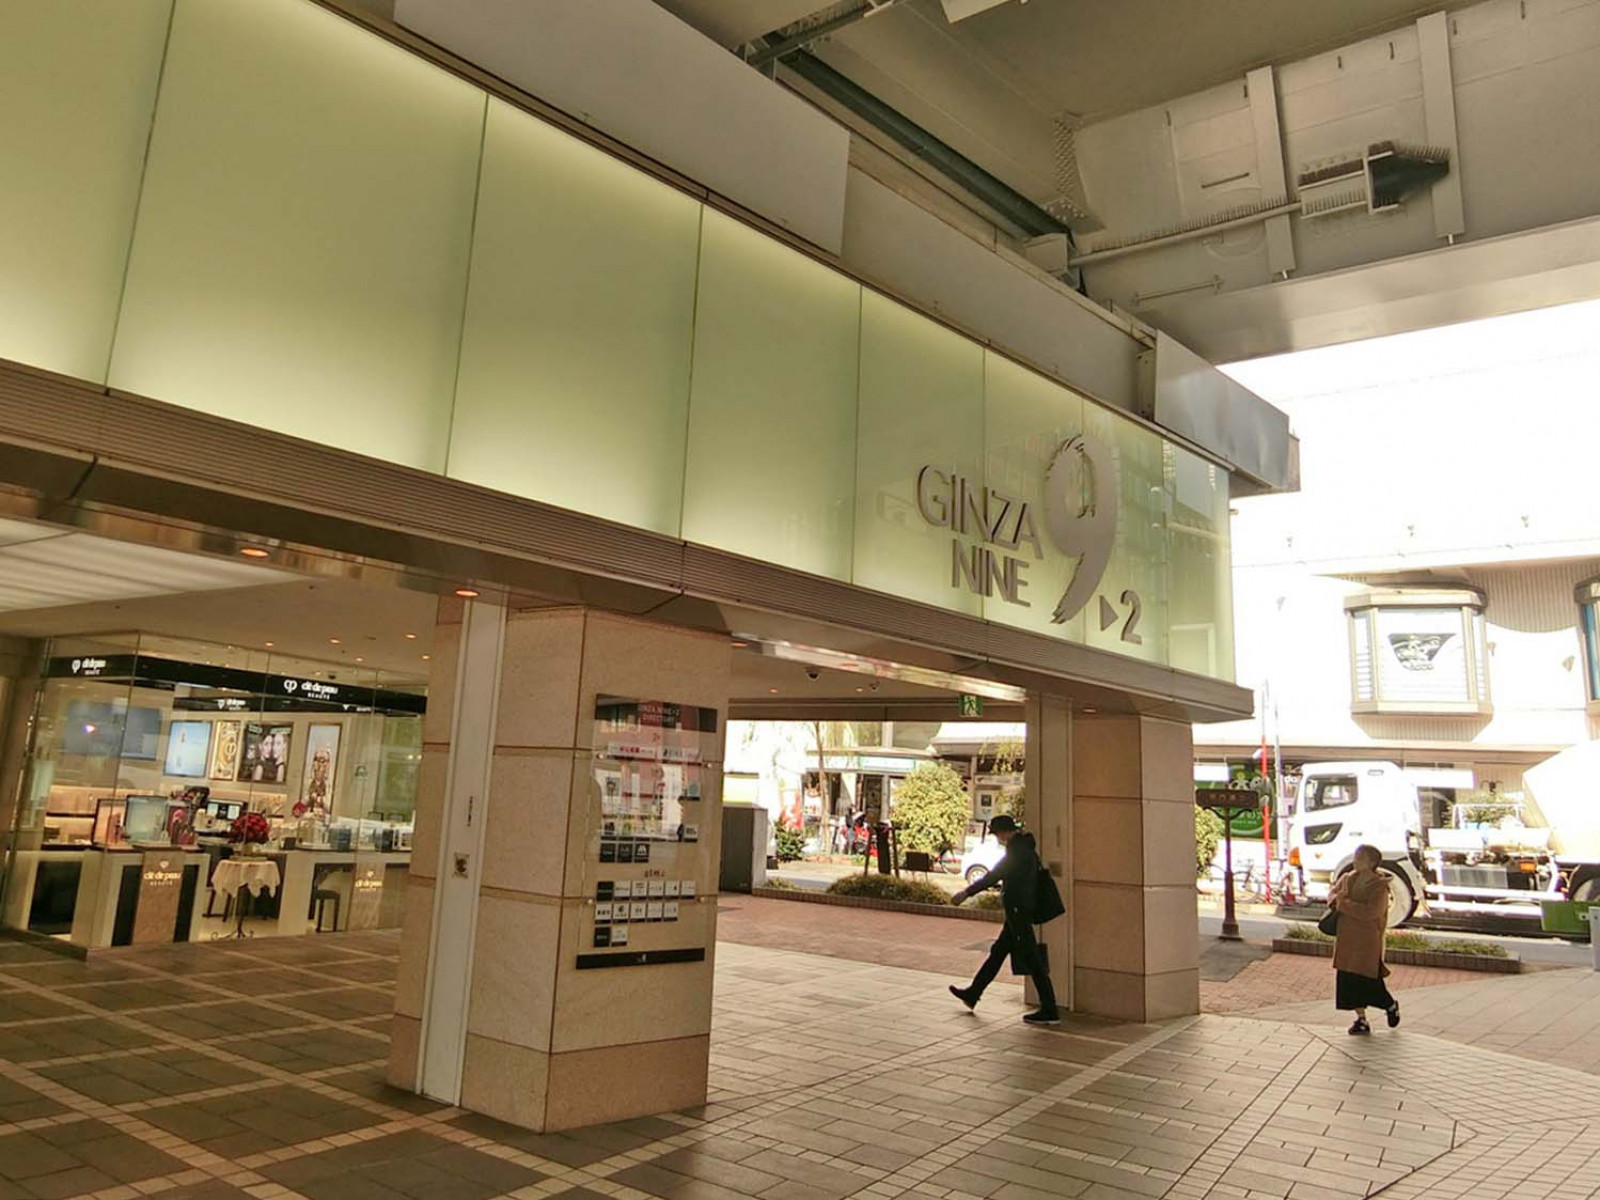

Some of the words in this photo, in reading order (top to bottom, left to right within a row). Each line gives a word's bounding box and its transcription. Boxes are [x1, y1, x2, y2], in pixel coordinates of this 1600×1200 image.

[917, 464, 1044, 560] GINZA
[951, 538, 1031, 608] NINE
[1120, 589, 1142, 645] 2
